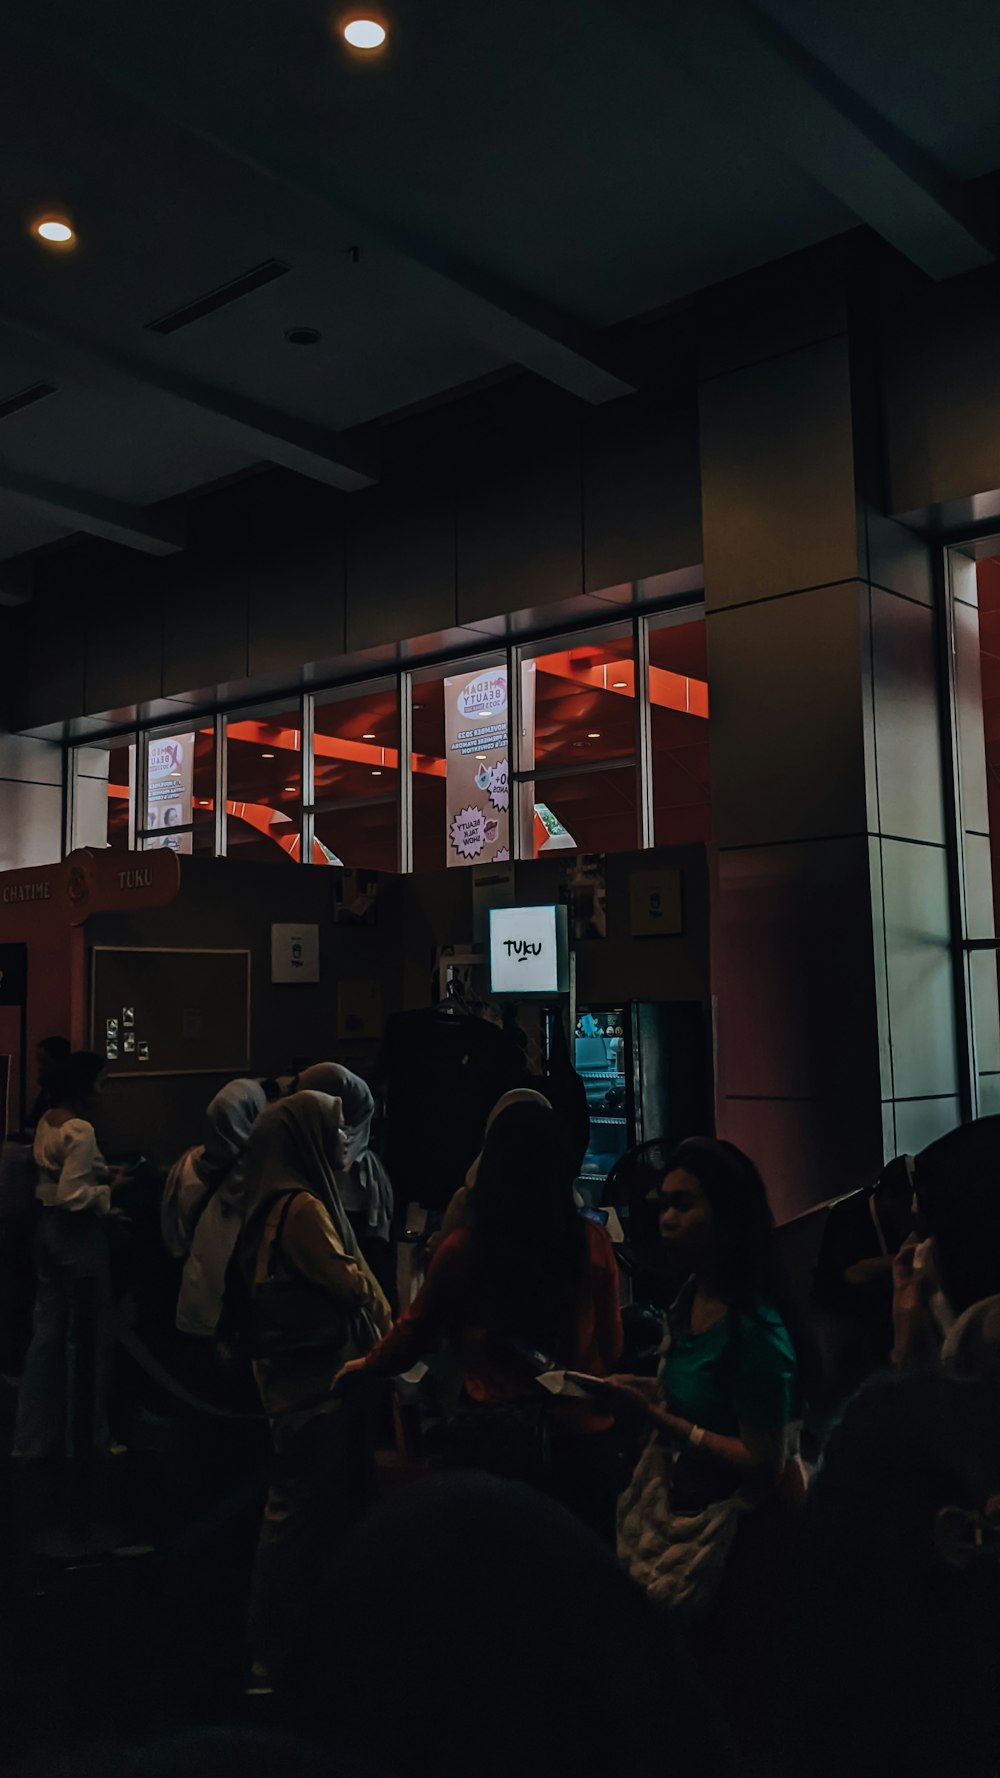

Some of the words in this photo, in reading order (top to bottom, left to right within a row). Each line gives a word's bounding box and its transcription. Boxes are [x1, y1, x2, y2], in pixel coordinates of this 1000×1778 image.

[117, 868, 153, 889] TUKU
[2, 882, 51, 904] CHATIME
[503, 940, 542, 958] TUKU
